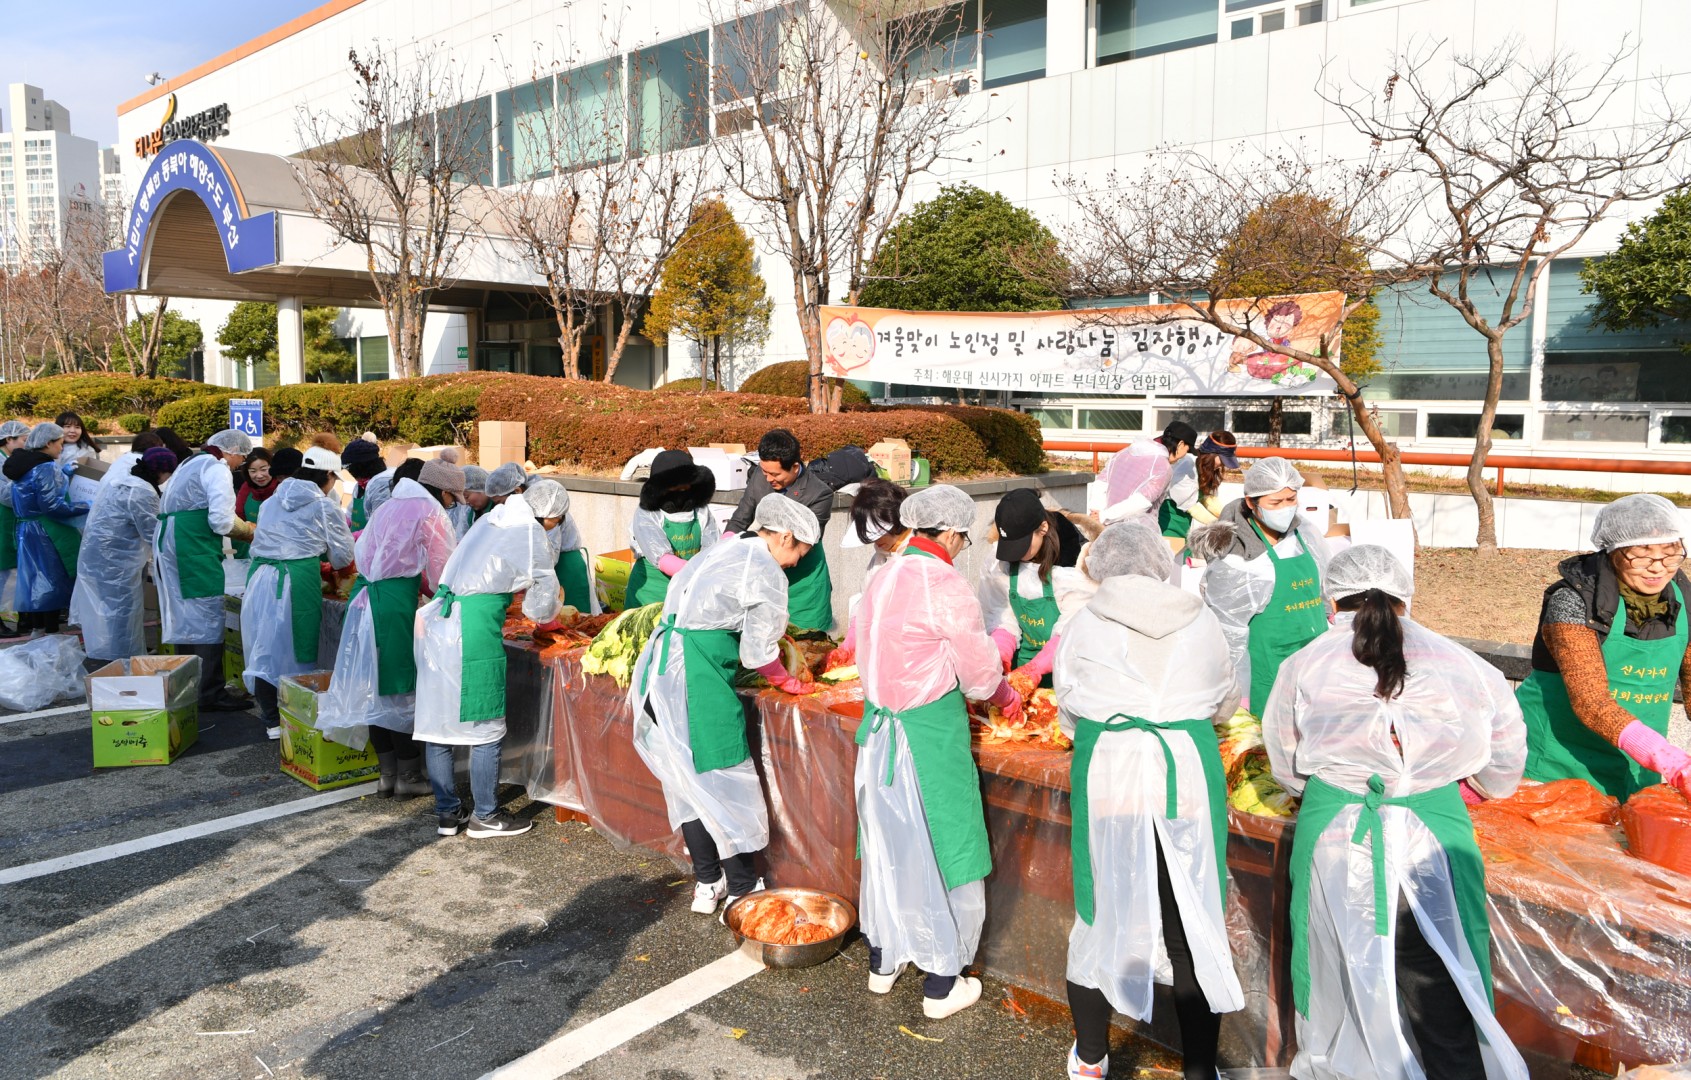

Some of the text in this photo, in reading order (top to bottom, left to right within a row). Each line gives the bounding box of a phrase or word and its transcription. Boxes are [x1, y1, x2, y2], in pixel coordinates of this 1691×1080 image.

[69, 200, 92, 212] LOTTE
[128, 152, 239, 266] 시민이 행복한 동북아 해양수도 부산
[877, 326, 1225, 358] 겨울맞이 노인정 및 사랑나눔 김장행사
[942, 370, 973, 385] 해운대
[979, 371, 1023, 388] 신시가지
[1030, 373, 1065, 388] 아파트
[1073, 374, 1124, 390] 부녀회장
[1131, 374, 1172, 391] 연합회
[234, 412, 244, 430] P
[1621, 665, 1667, 679] 신시가지
